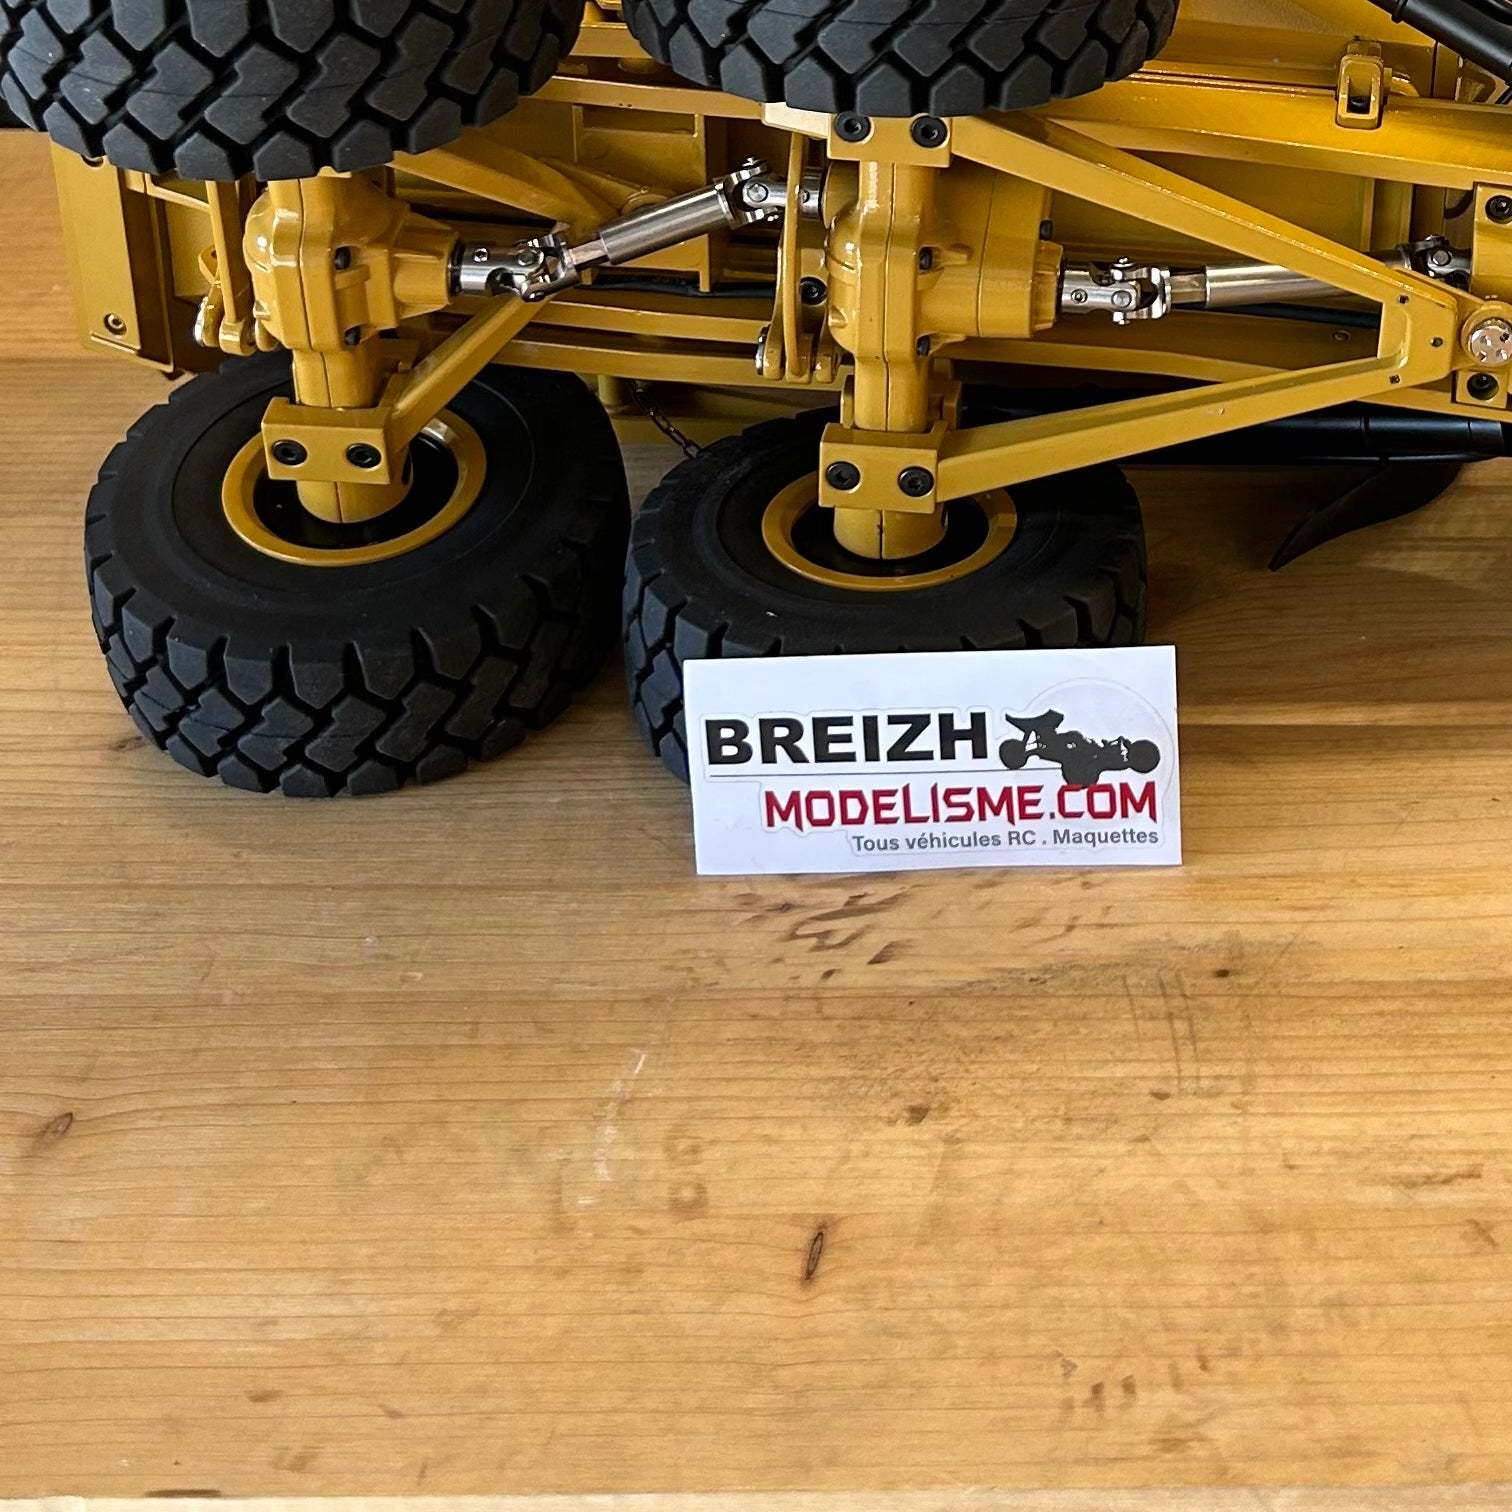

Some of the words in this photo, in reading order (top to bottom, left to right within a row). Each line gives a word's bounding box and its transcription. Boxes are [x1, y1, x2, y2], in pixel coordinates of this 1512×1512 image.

[705, 711, 989, 765] BREIZH
[764, 780, 1157, 832] MODELISME.COM
[852, 835, 900, 852] Tous
[905, 831, 1001, 850] véhicules
[1008, 831, 1037, 847] RC
[1053, 828, 1159, 848] Maquettes
